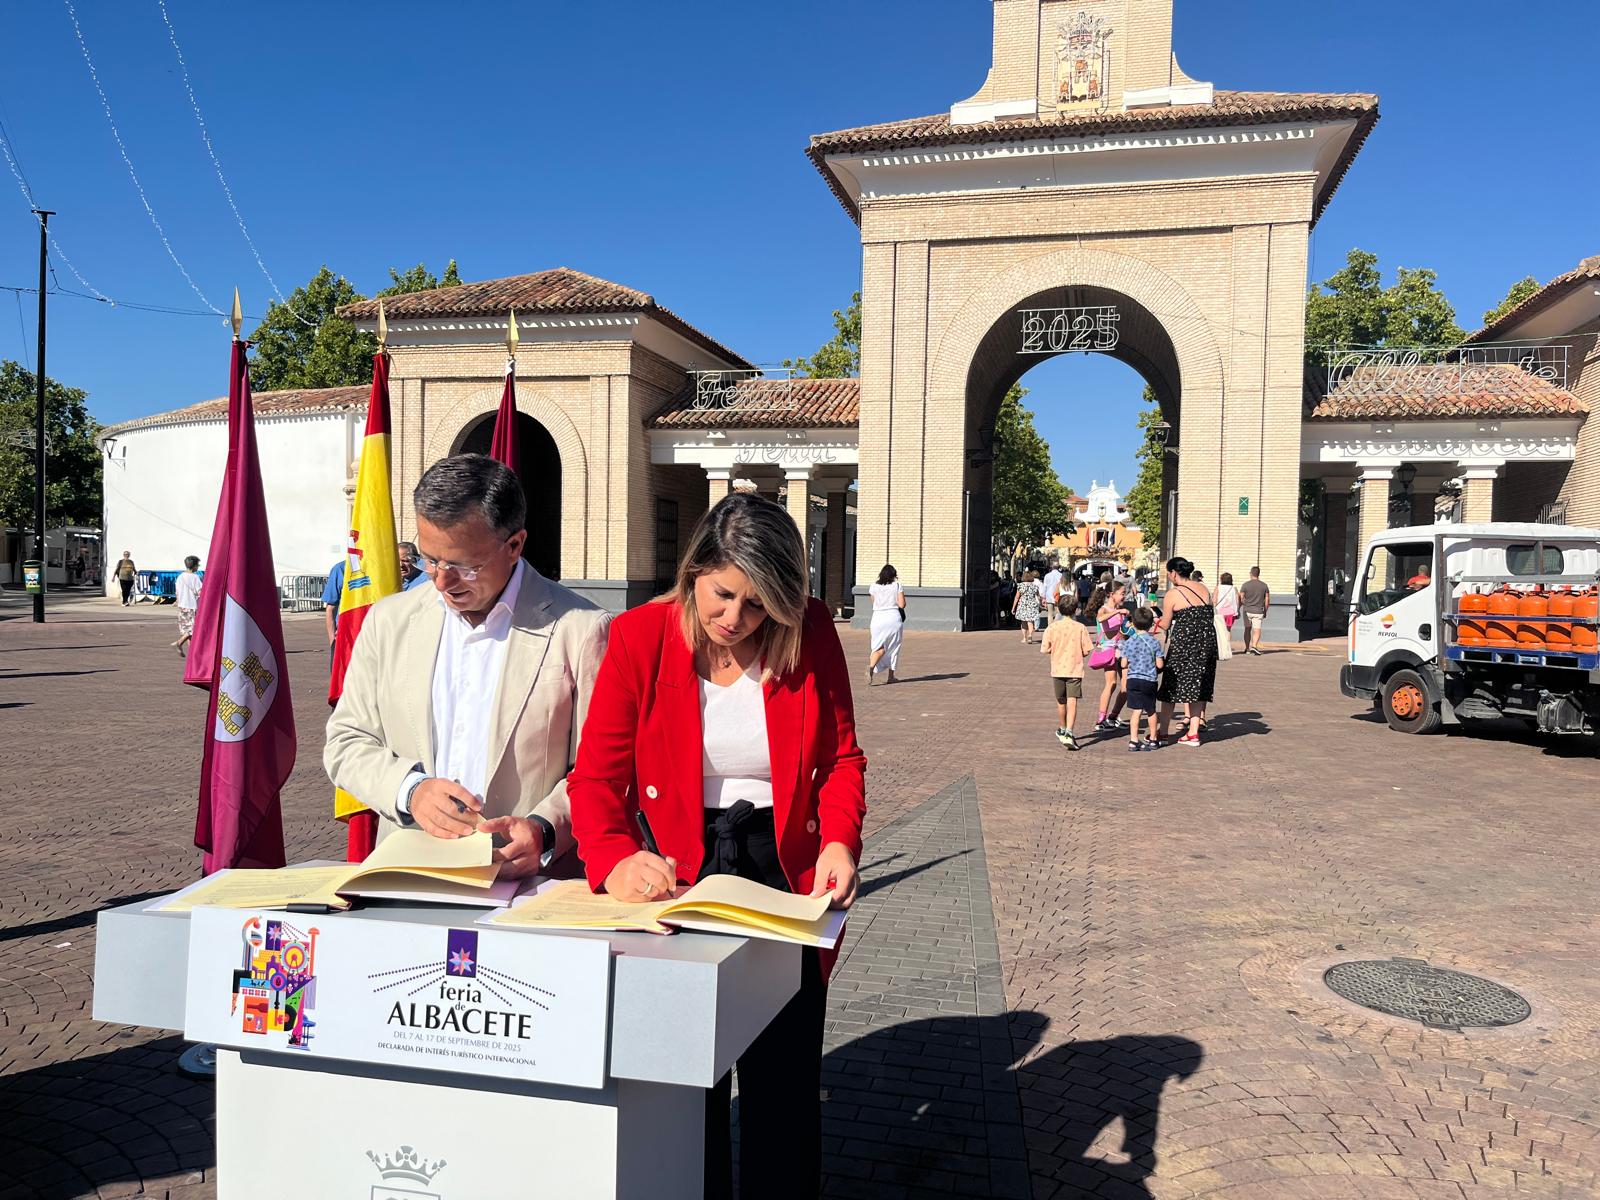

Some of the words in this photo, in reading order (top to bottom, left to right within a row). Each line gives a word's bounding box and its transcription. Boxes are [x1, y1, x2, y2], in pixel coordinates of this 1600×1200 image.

[1022, 313, 1120, 351] 2025
[692, 373, 799, 410] Feria
[439, 980, 482, 1004] feria
[454, 1001, 467, 1012] de
[386, 1000, 532, 1040] ALBACETE
[377, 1041, 414, 1052] DECLARADA
[415, 1045, 424, 1054] DE
[425, 1046, 450, 1056] INTERÉS
[451, 1050, 484, 1060] TURÍSTICO
[485, 1055, 537, 1066] INTERNACIONAL
[393, 1030, 407, 1040] DEL
[409, 1032, 414, 1041] 7
[415, 1032, 424, 1041] AL
[426, 1034, 435, 1042] 17
[436, 1035, 446, 1044] DE
[448, 1036, 490, 1049] SEPTIEMBRE
[492, 1041, 502, 1050] DE
[503, 1043, 521, 1053] 2025
